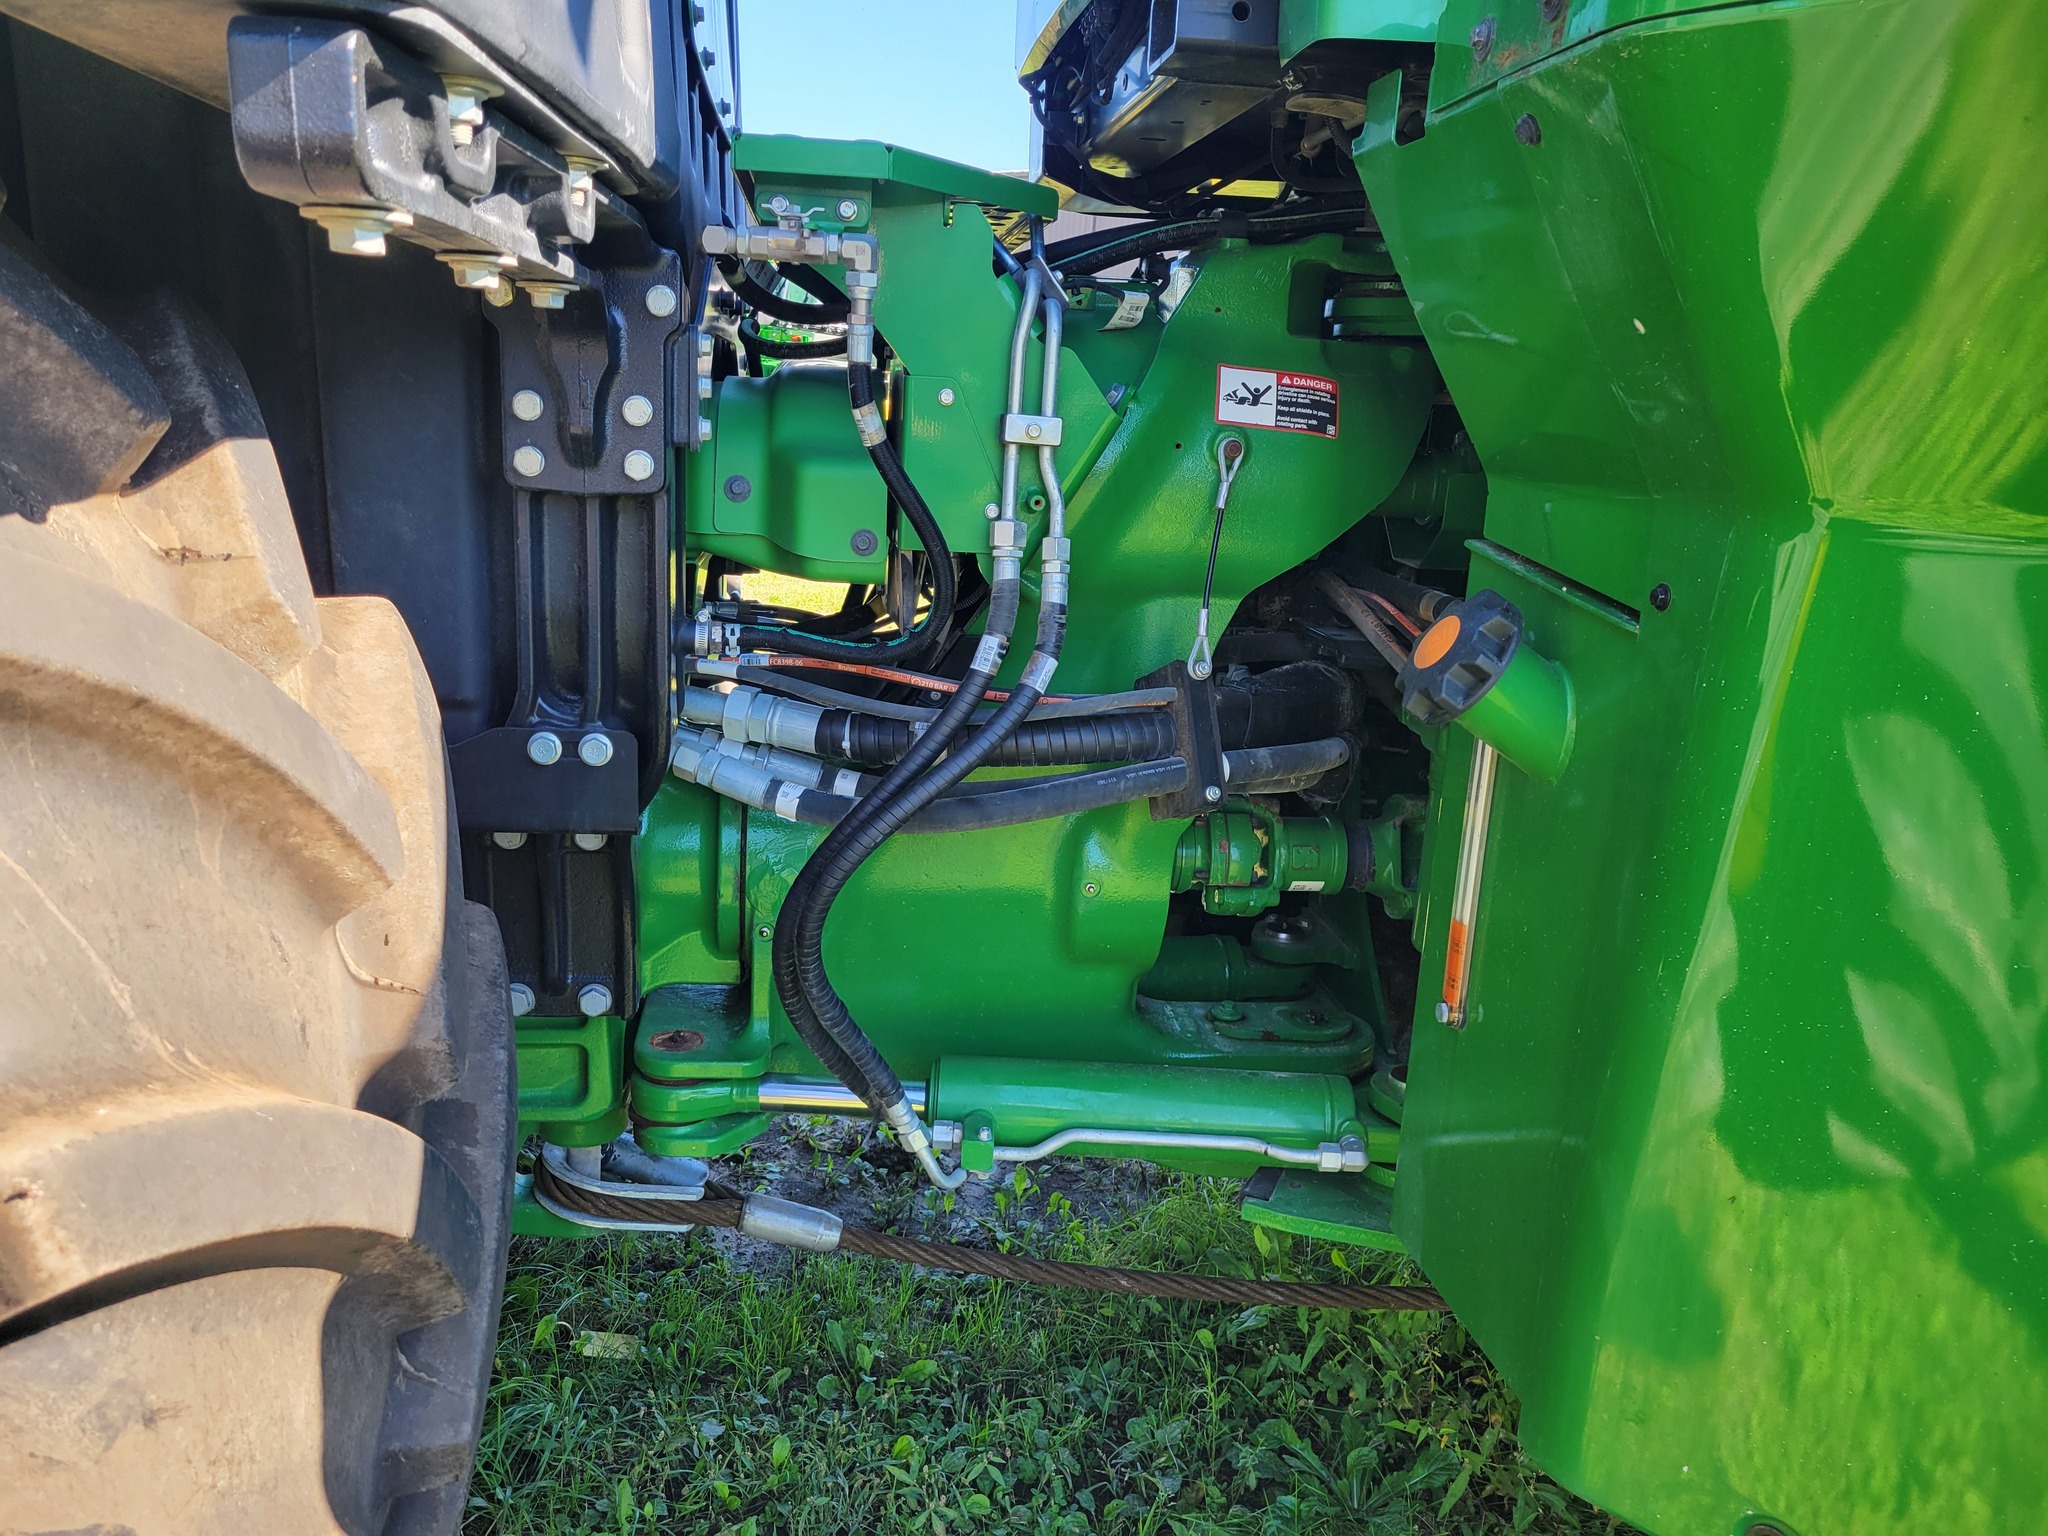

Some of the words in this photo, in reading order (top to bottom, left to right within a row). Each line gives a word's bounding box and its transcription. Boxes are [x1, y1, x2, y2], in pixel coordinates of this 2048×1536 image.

[1293, 377, 1333, 391] DANGER
[1278, 385, 1309, 394] Entanglement
[1315, 390, 1331, 398] rotating
[1320, 396, 1336, 404] serious
[1318, 410, 1331, 418] place.
[769, 657, 804, 667] FC839B-06
[837, 663, 858, 673] Bruiser
[920, 680, 934, 689] 210
[934, 683, 948, 692] BAR
